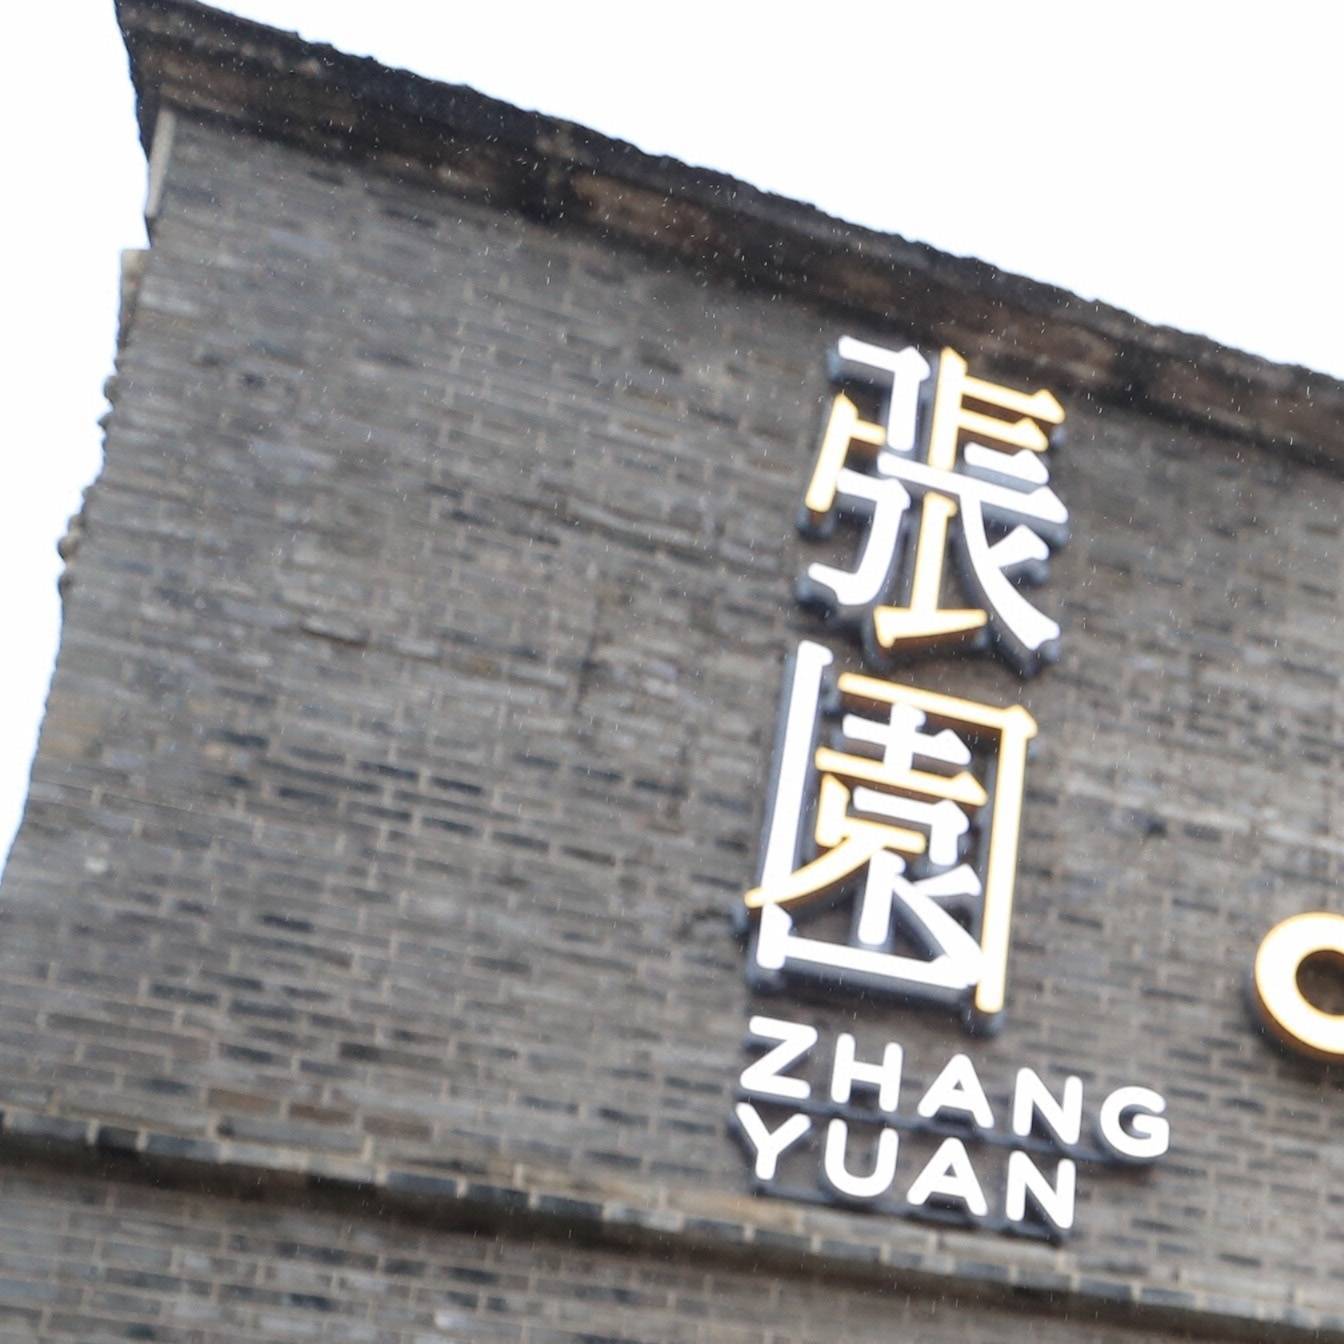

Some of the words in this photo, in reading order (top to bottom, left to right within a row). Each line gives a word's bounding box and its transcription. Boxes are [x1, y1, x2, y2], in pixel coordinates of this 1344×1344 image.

[744, 335, 1068, 1013] 張園
[739, 1015, 1170, 1158] ZHANG
[734, 1102, 1077, 1230] YUAN
